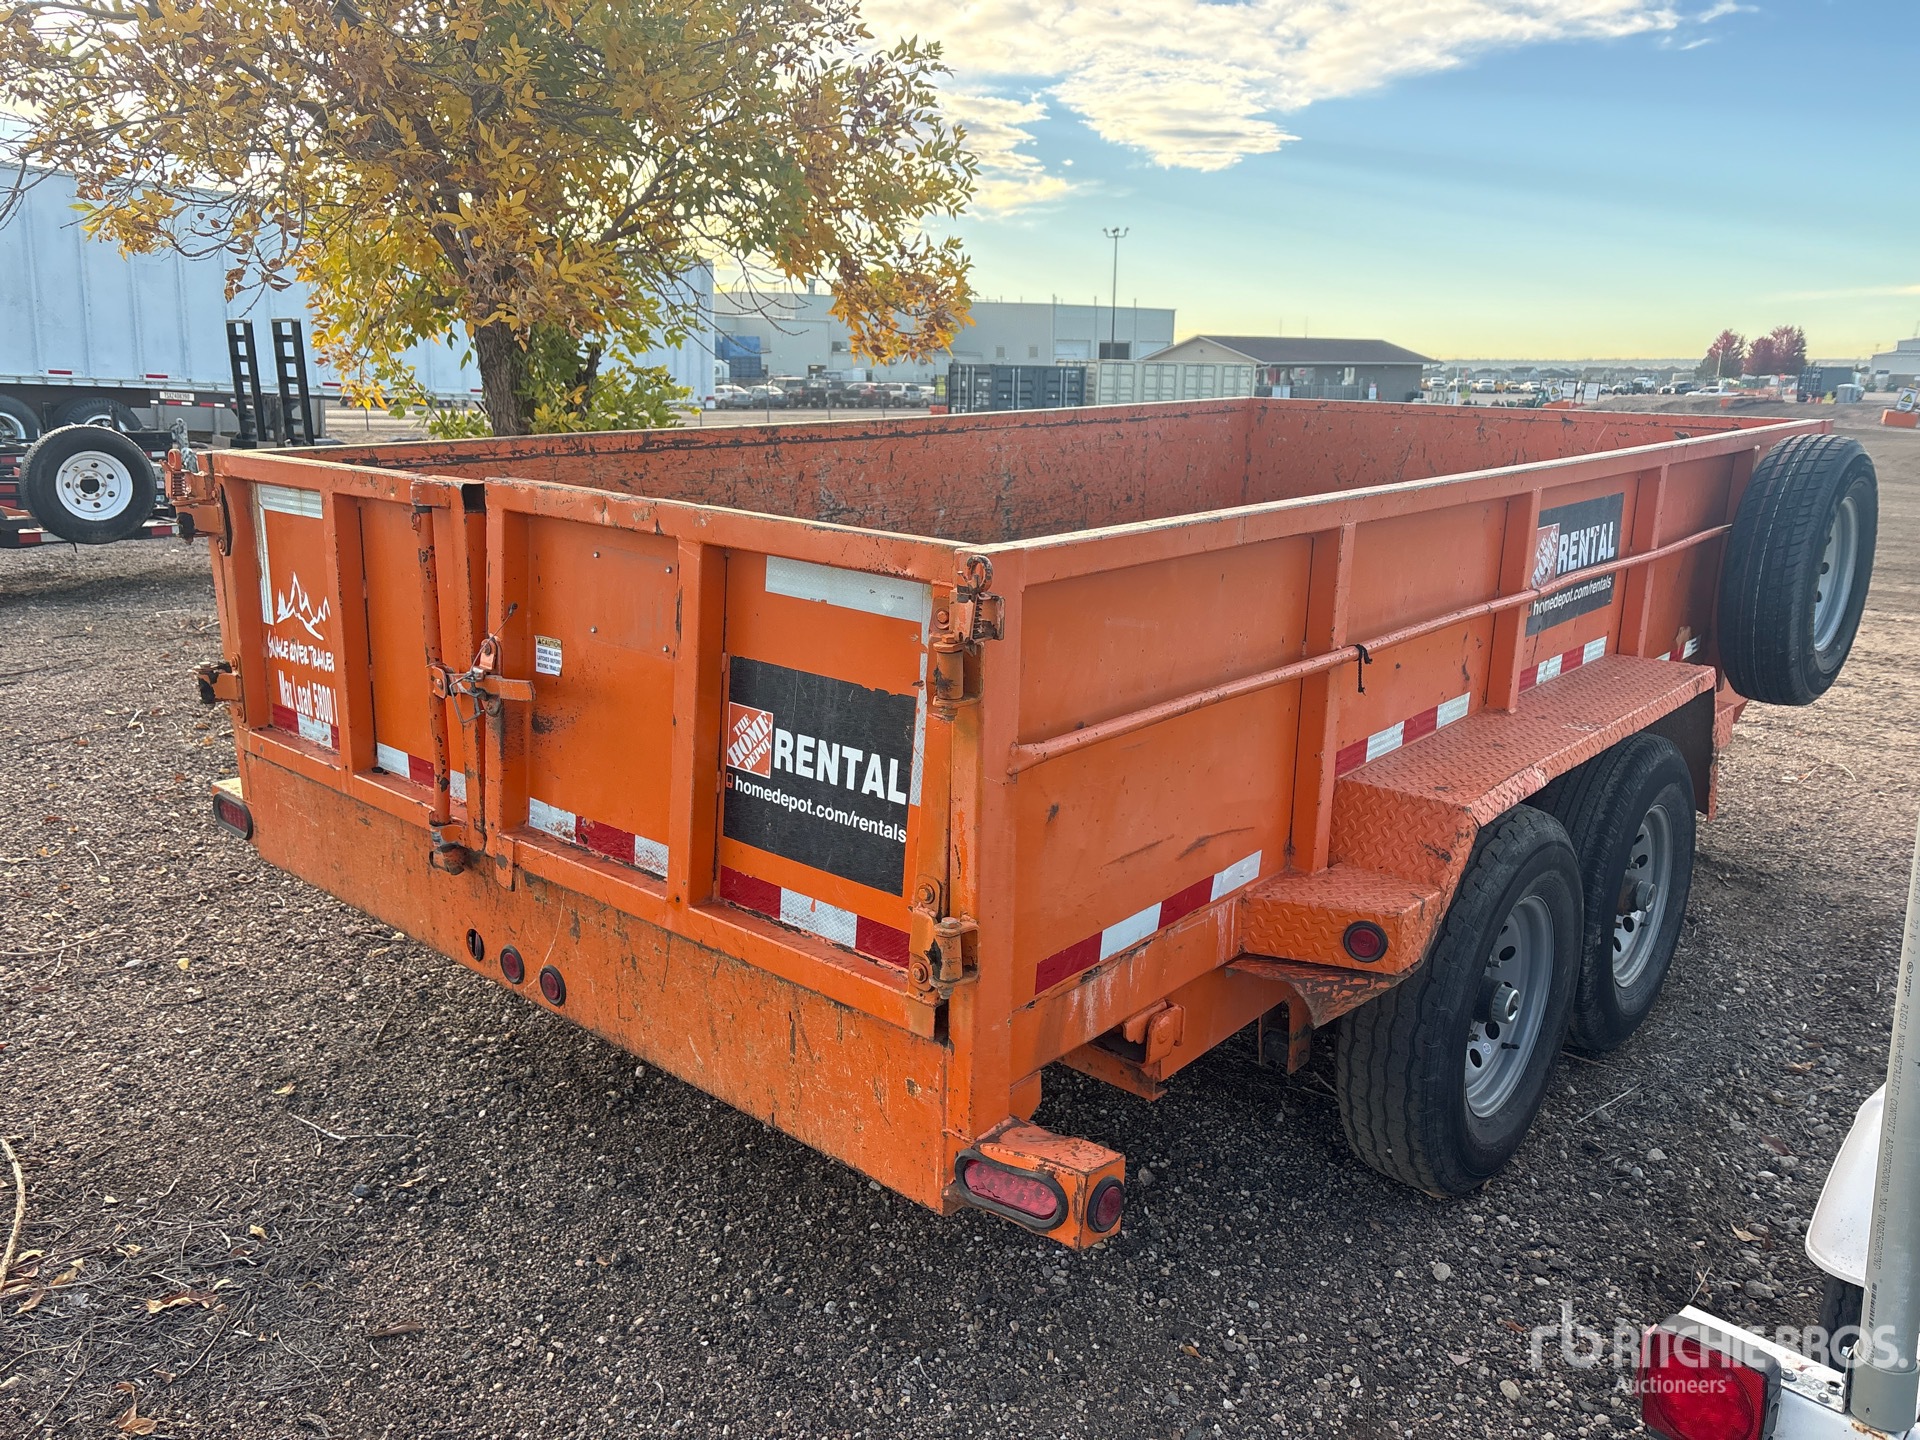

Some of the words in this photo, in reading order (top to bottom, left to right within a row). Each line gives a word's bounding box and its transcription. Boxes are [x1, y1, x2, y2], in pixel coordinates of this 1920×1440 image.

[1556, 521, 1615, 575] RENTAL
[1532, 575, 1612, 616] homedepot.com/rentals
[278, 669, 295, 710] Max
[292, 675, 314, 717] Load
[727, 711, 772, 767] HOME
[732, 713, 752, 737] THE
[743, 736, 772, 770] DEPOT
[773, 727, 907, 805] RENTAL
[735, 776, 907, 843] homedepot.com/rentals
[1899, 1003, 1909, 1030] RIGID
[1890, 1032, 1906, 1096] NON-METALLIC
